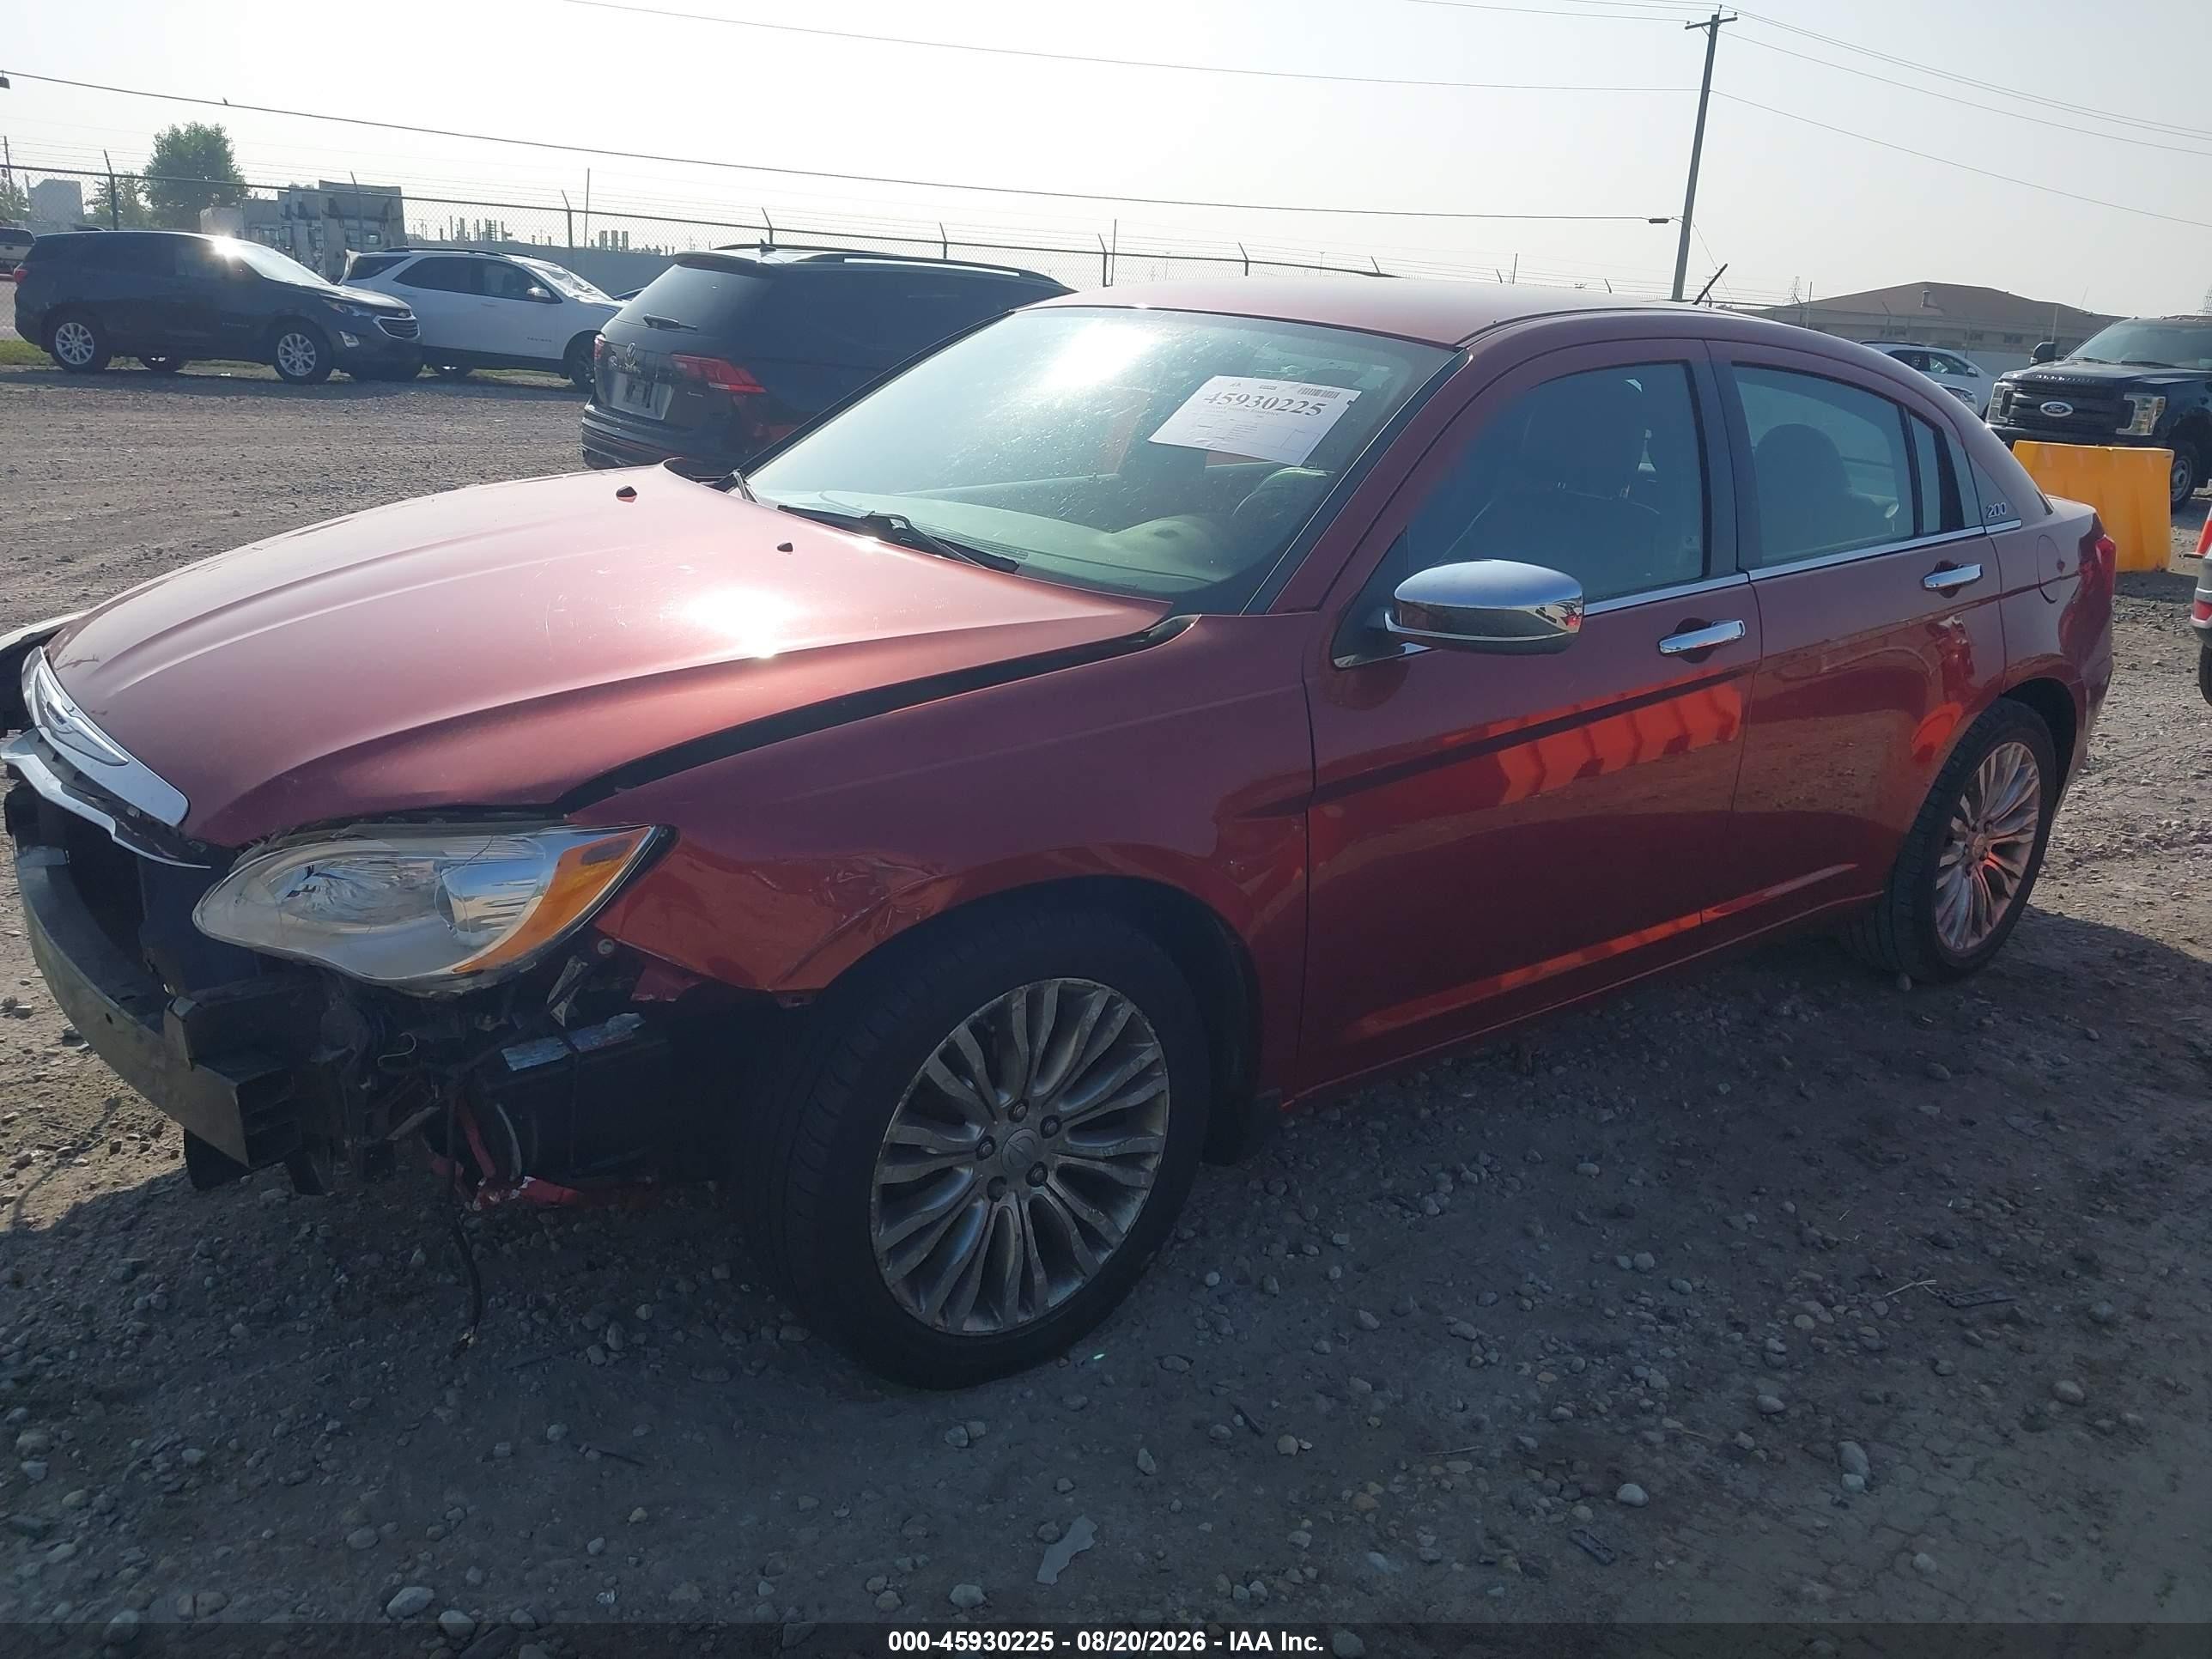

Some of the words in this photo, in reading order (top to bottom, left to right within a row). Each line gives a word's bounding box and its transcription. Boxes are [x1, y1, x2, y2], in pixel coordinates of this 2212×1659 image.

[1204, 392, 1328, 416] 45930225
[2047, 404, 2063, 413] Ford
[1986, 502, 2007, 519] 200
